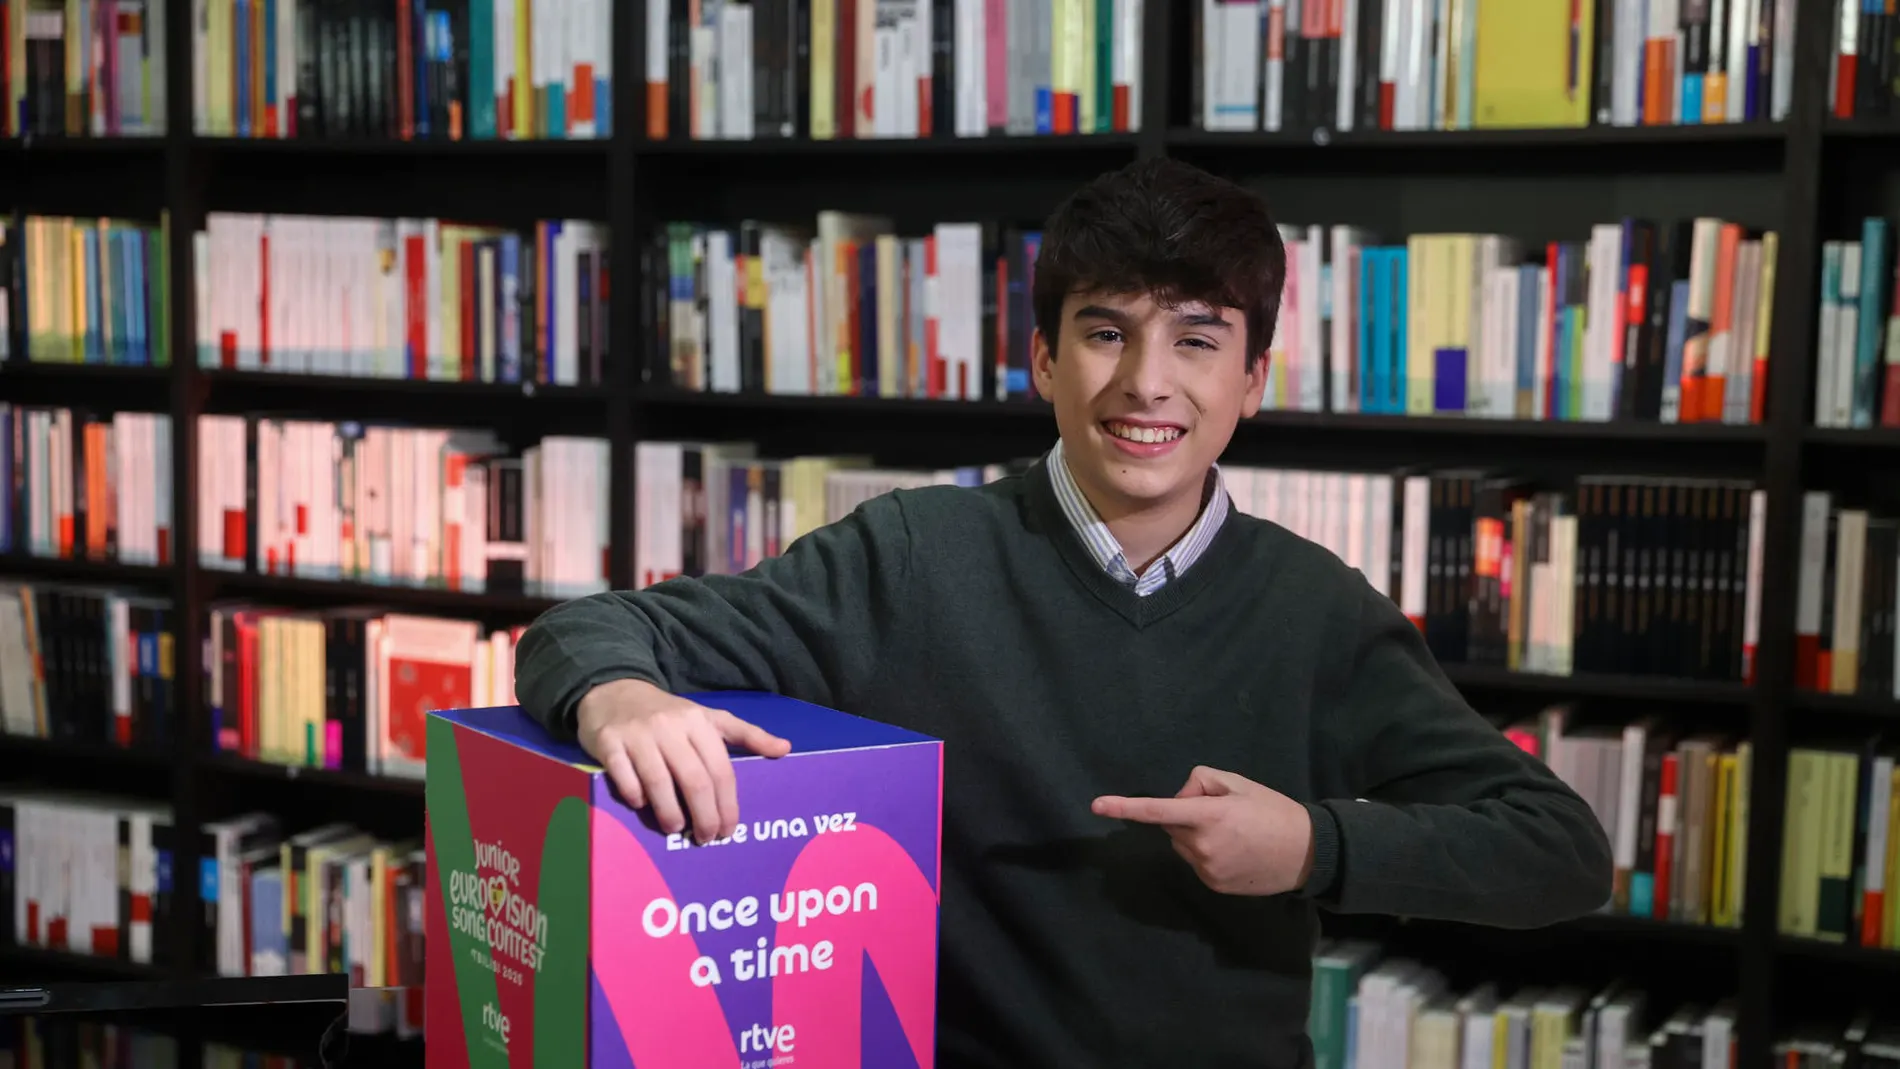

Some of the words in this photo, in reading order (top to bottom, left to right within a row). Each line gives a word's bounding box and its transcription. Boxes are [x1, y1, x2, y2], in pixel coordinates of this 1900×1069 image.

[753, 817, 808, 842] una
[813, 812, 857, 835] vez
[641, 895, 759, 938] Once
[769, 881, 878, 928] upon
[689, 955, 722, 988] a
[730, 936, 834, 982] time
[483, 1001, 511, 1044] rtve
[740, 1022, 796, 1054] rtve
